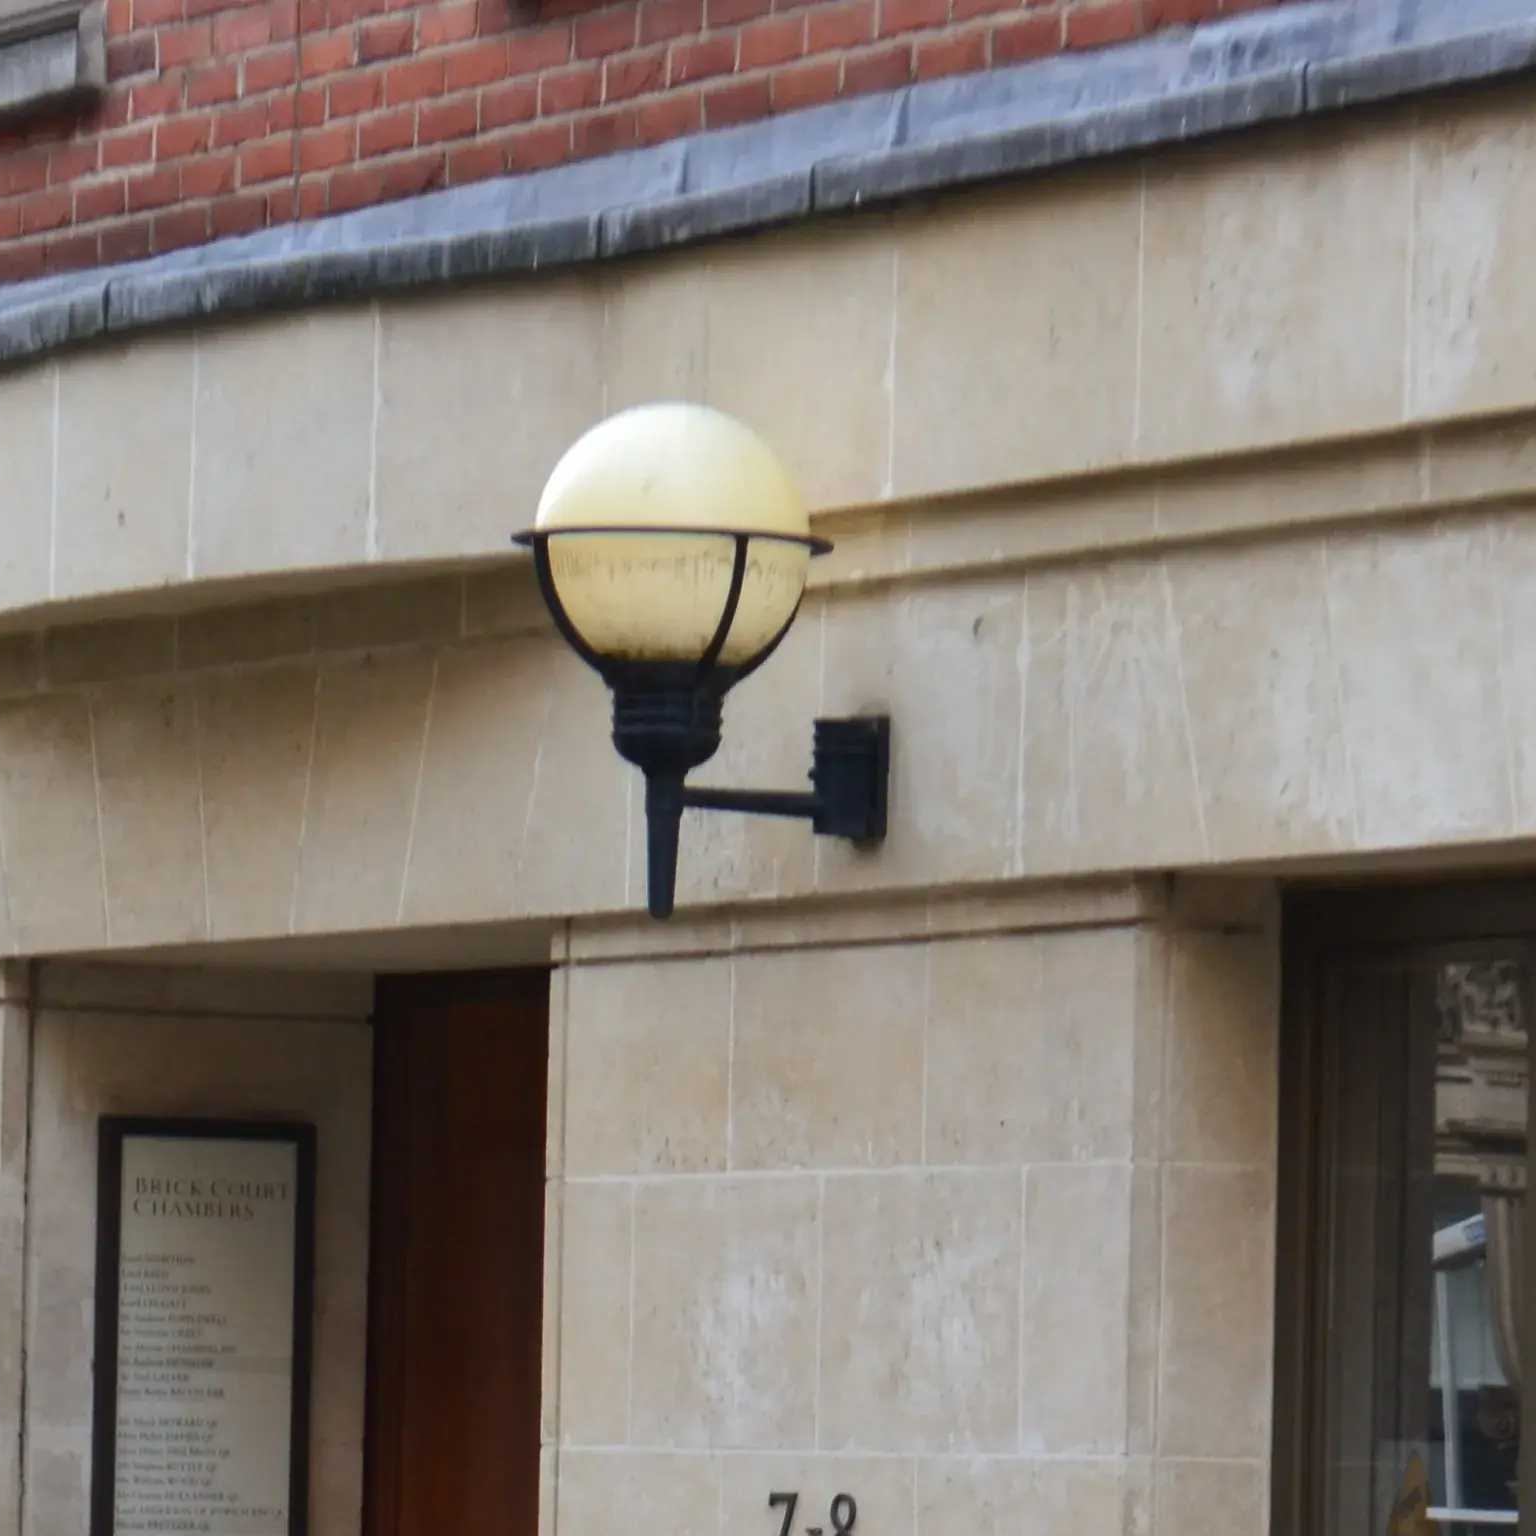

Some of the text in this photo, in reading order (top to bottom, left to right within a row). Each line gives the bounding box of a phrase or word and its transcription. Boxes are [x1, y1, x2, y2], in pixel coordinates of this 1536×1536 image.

[135, 1176, 290, 1200] BRICK COURT
[133, 1198, 254, 1219] CHAMBERS
